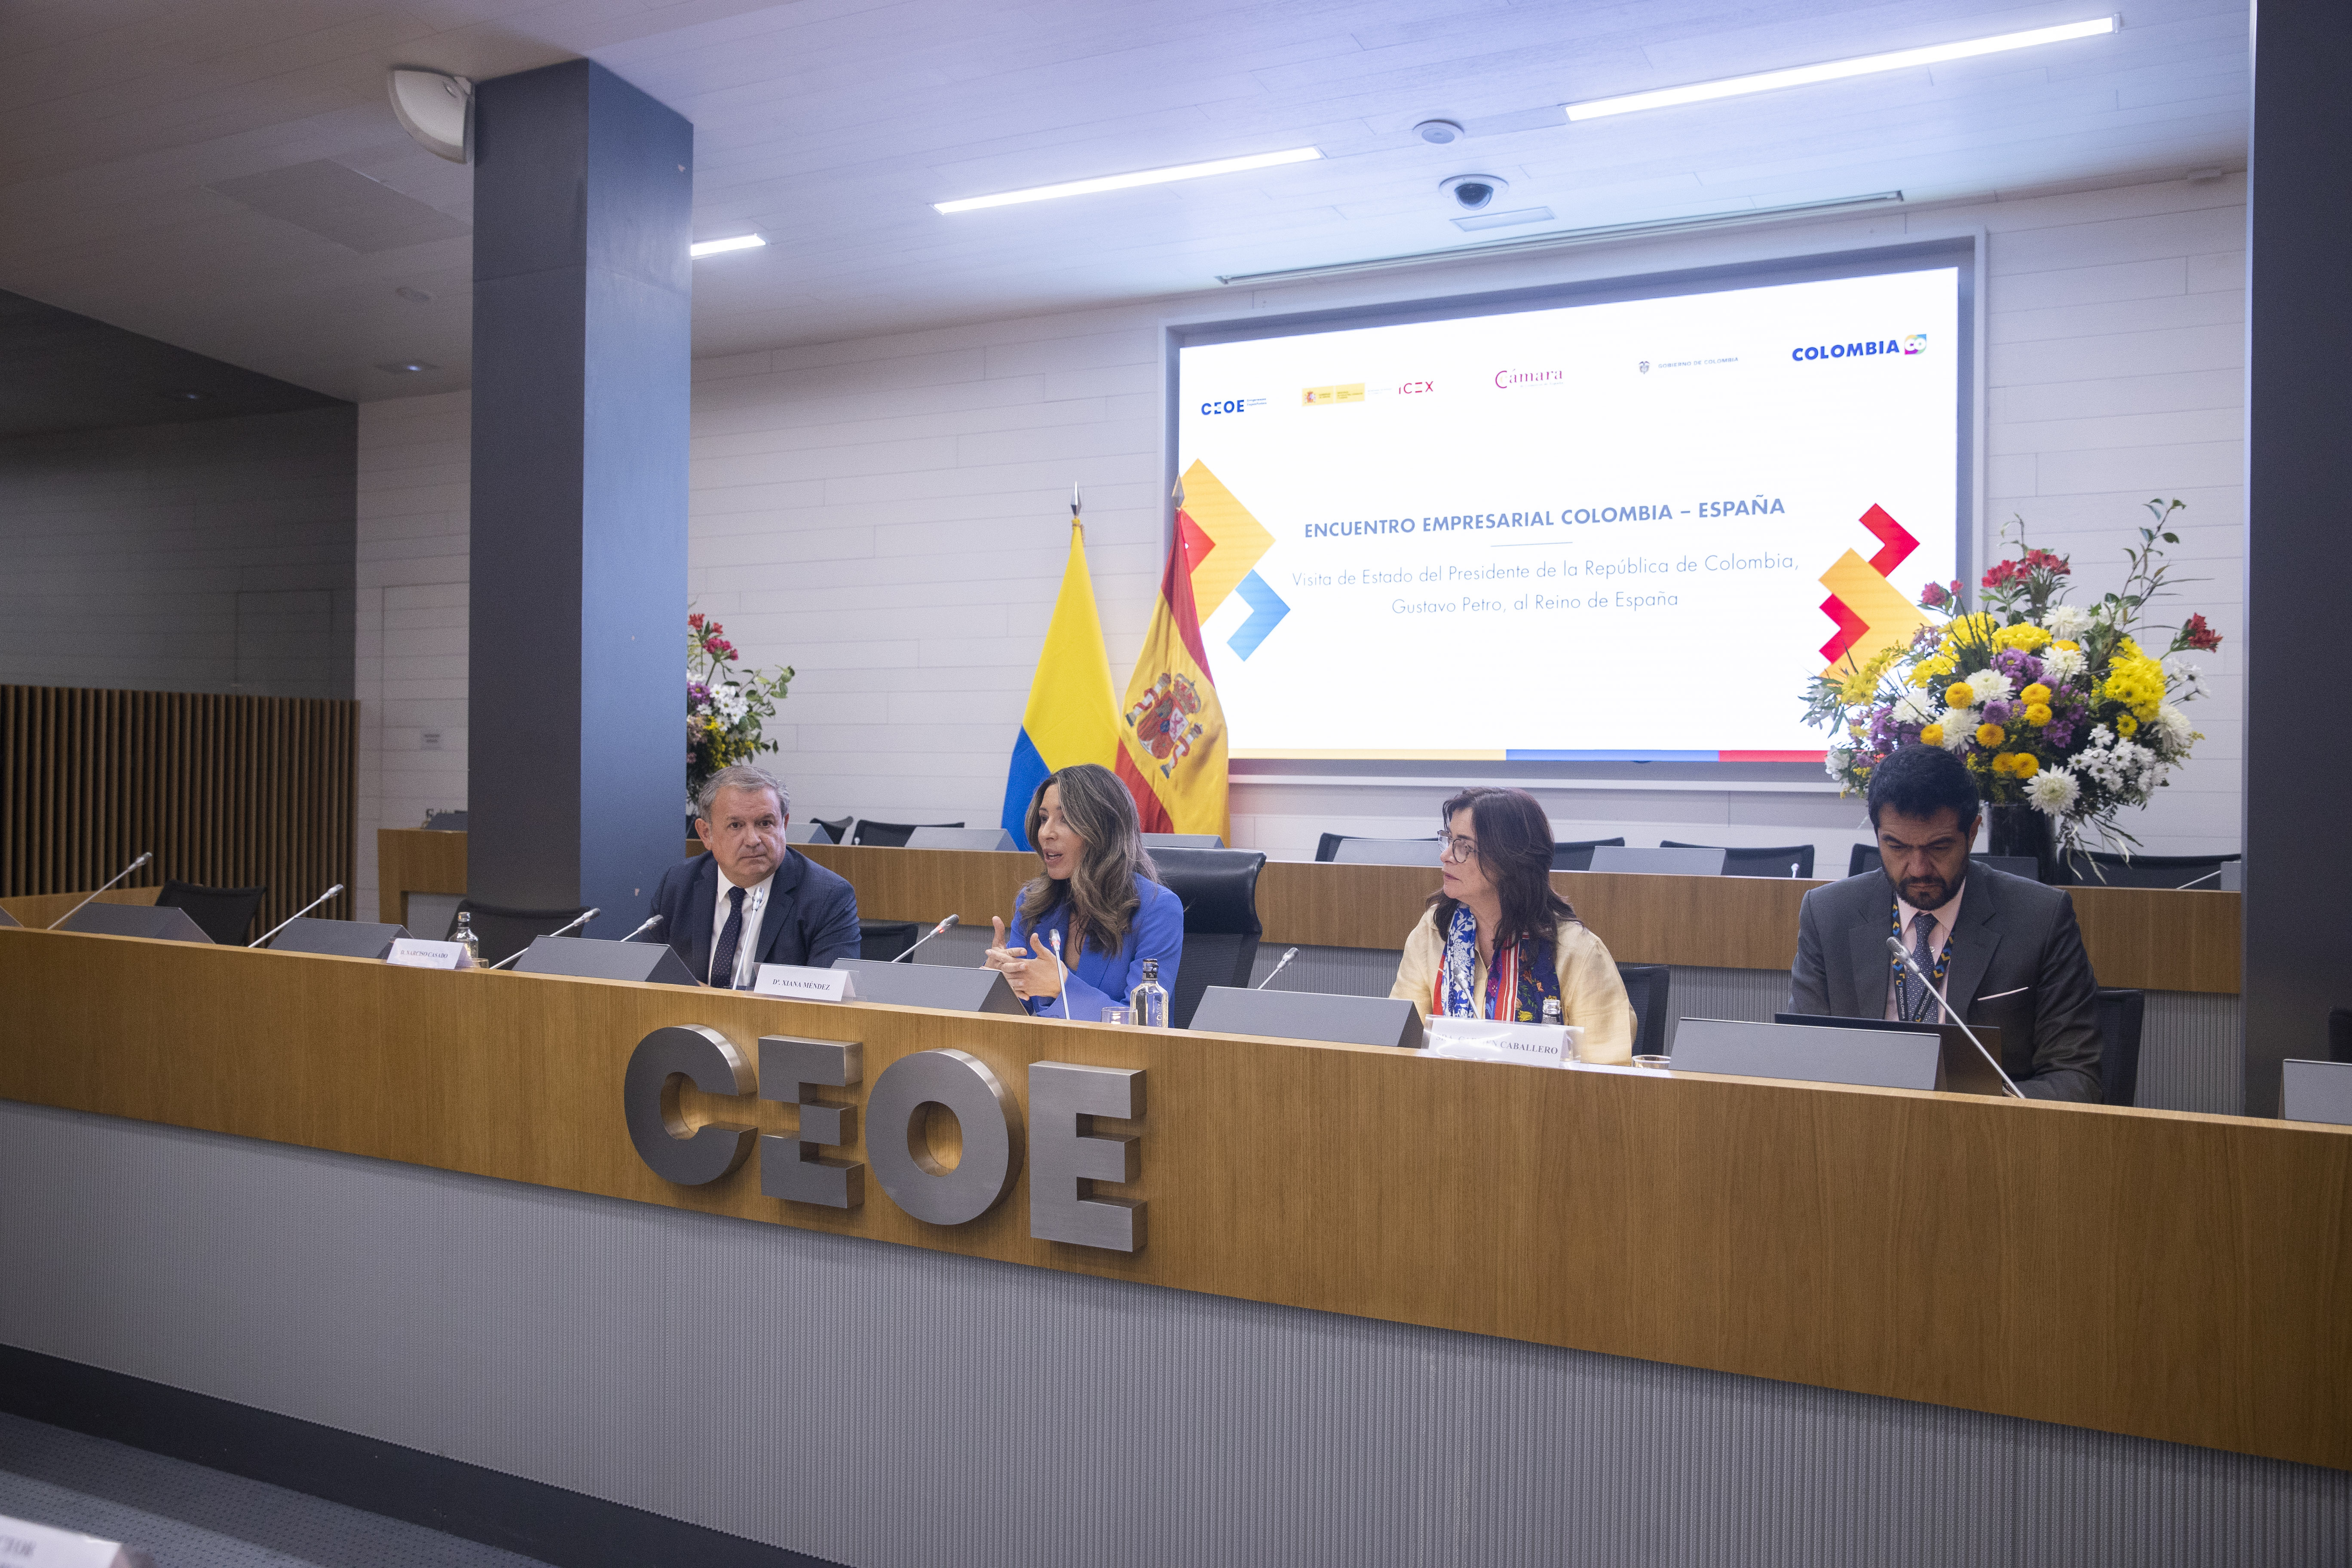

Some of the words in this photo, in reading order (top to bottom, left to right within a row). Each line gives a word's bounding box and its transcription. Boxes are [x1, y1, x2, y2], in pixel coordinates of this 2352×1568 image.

[1792, 339, 1900, 362] COLOMBIA
[1495, 368, 1562, 389] Cámara
[1201, 399, 1244, 416] CEOE
[1305, 518, 1415, 538] ENCUENTRO
[1423, 511, 1554, 532] EMPRESARIAL
[1561, 504, 1673, 525] COLOMBIA
[1699, 494, 1785, 518] ESPAÑA
[1292, 573, 1331, 586] Visita
[1338, 569, 1356, 585] de
[1363, 567, 1412, 584] Estado
[1419, 565, 1441, 582] del
[1449, 563, 1529, 581] Presidente
[1536, 560, 1556, 578] de
[1564, 560, 1577, 576] la
[1586, 557, 1668, 580] República
[1676, 555, 1697, 572] de
[1705, 551, 1798, 571] Colombia,
[1392, 599, 1456, 614] Gustavo
[1463, 597, 1506, 612] Petro,
[1514, 593, 1528, 610] al
[1536, 594, 1580, 609] Reino
[1588, 591, 1608, 608] de
[1616, 591, 1678, 612] España
[803, 981, 830, 990] MÉNDEZ
[1500, 1041, 1558, 1054] CABALLERO
[624, 1024, 1147, 1252] CEOE
